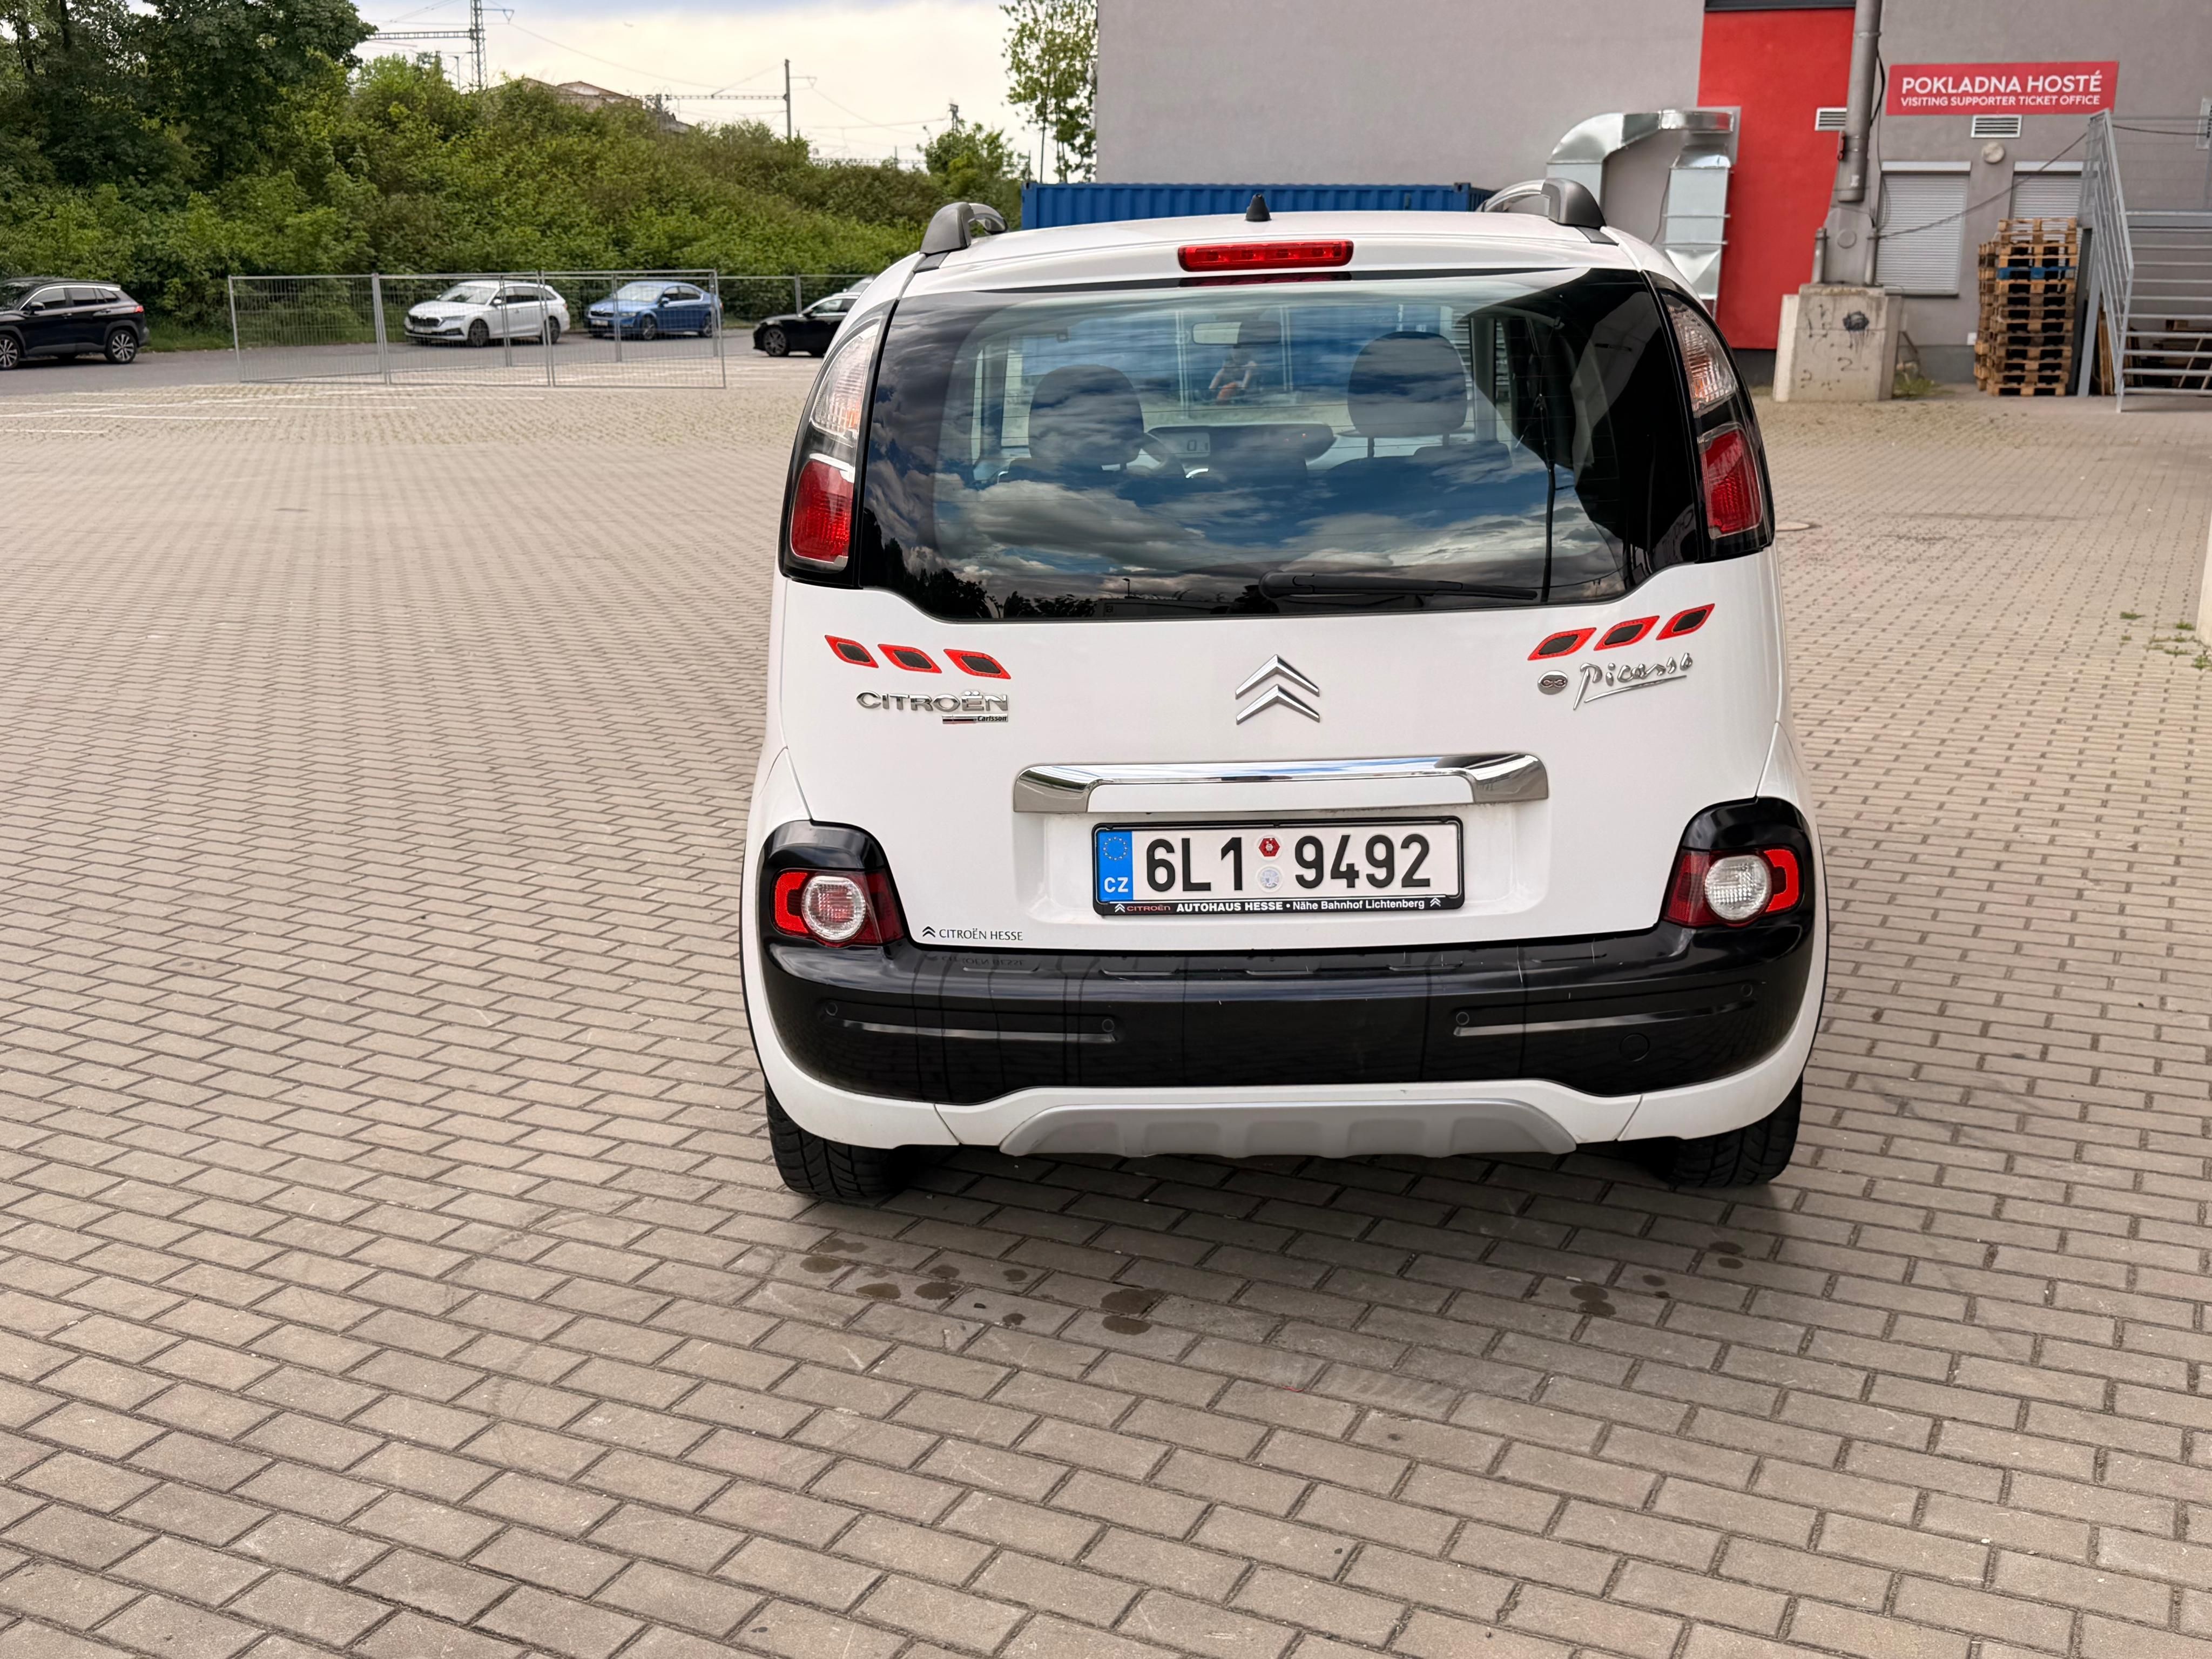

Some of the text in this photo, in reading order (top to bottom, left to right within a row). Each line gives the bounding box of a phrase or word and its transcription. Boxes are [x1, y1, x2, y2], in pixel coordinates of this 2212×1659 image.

[1901, 70, 2103, 95] POKLADNA HOSTÉ
[1901, 95, 2100, 106] VISITING SUPPORTER TICKET OFFICE
[1573, 652, 1693, 711] Picasso
[856, 691, 1009, 712] CITROËN
[1146, 833, 1431, 892] 6L1 9492
[1104, 877, 1129, 893] CZ
[1176, 902, 1241, 912] AUTOHAUS
[1245, 901, 1283, 911] HESSE
[1293, 901, 1318, 910] Nähe
[1321, 900, 1363, 909] Bahnhof
[1366, 899, 1425, 909] Lichtenberg
[939, 928, 1023, 941] CITROËN HESSE
